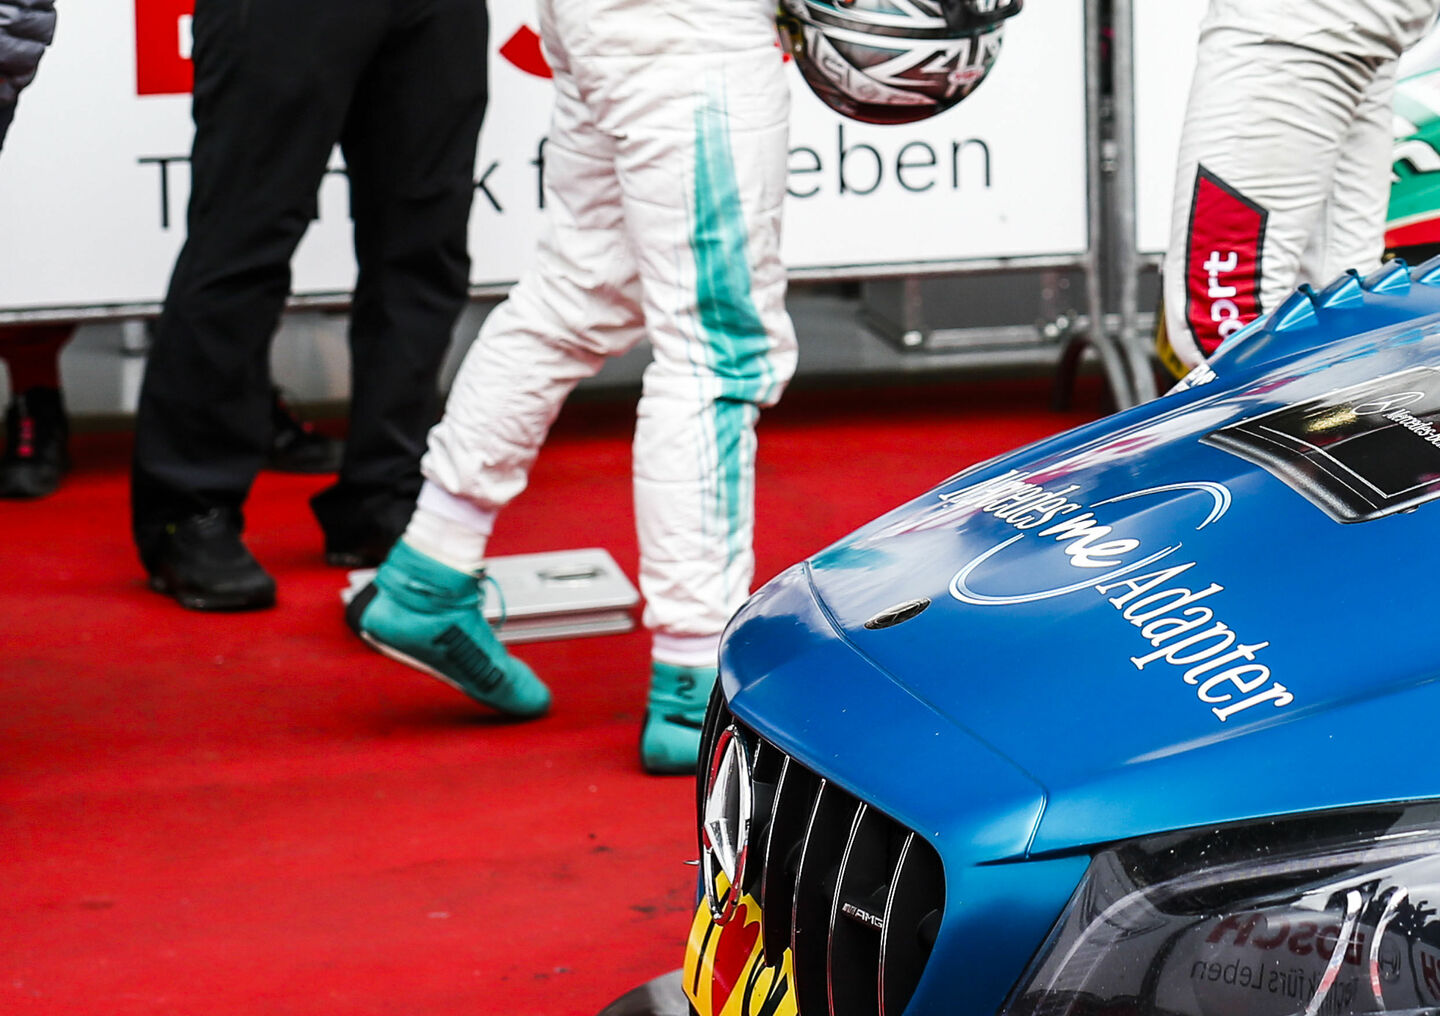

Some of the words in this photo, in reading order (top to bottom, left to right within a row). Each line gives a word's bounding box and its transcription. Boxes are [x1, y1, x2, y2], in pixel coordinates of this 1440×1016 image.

[787, 124, 992, 199] eben
[1038, 510, 1141, 569] me
[1094, 561, 1295, 723] Adapter
[855, 908, 884, 930] AMG
